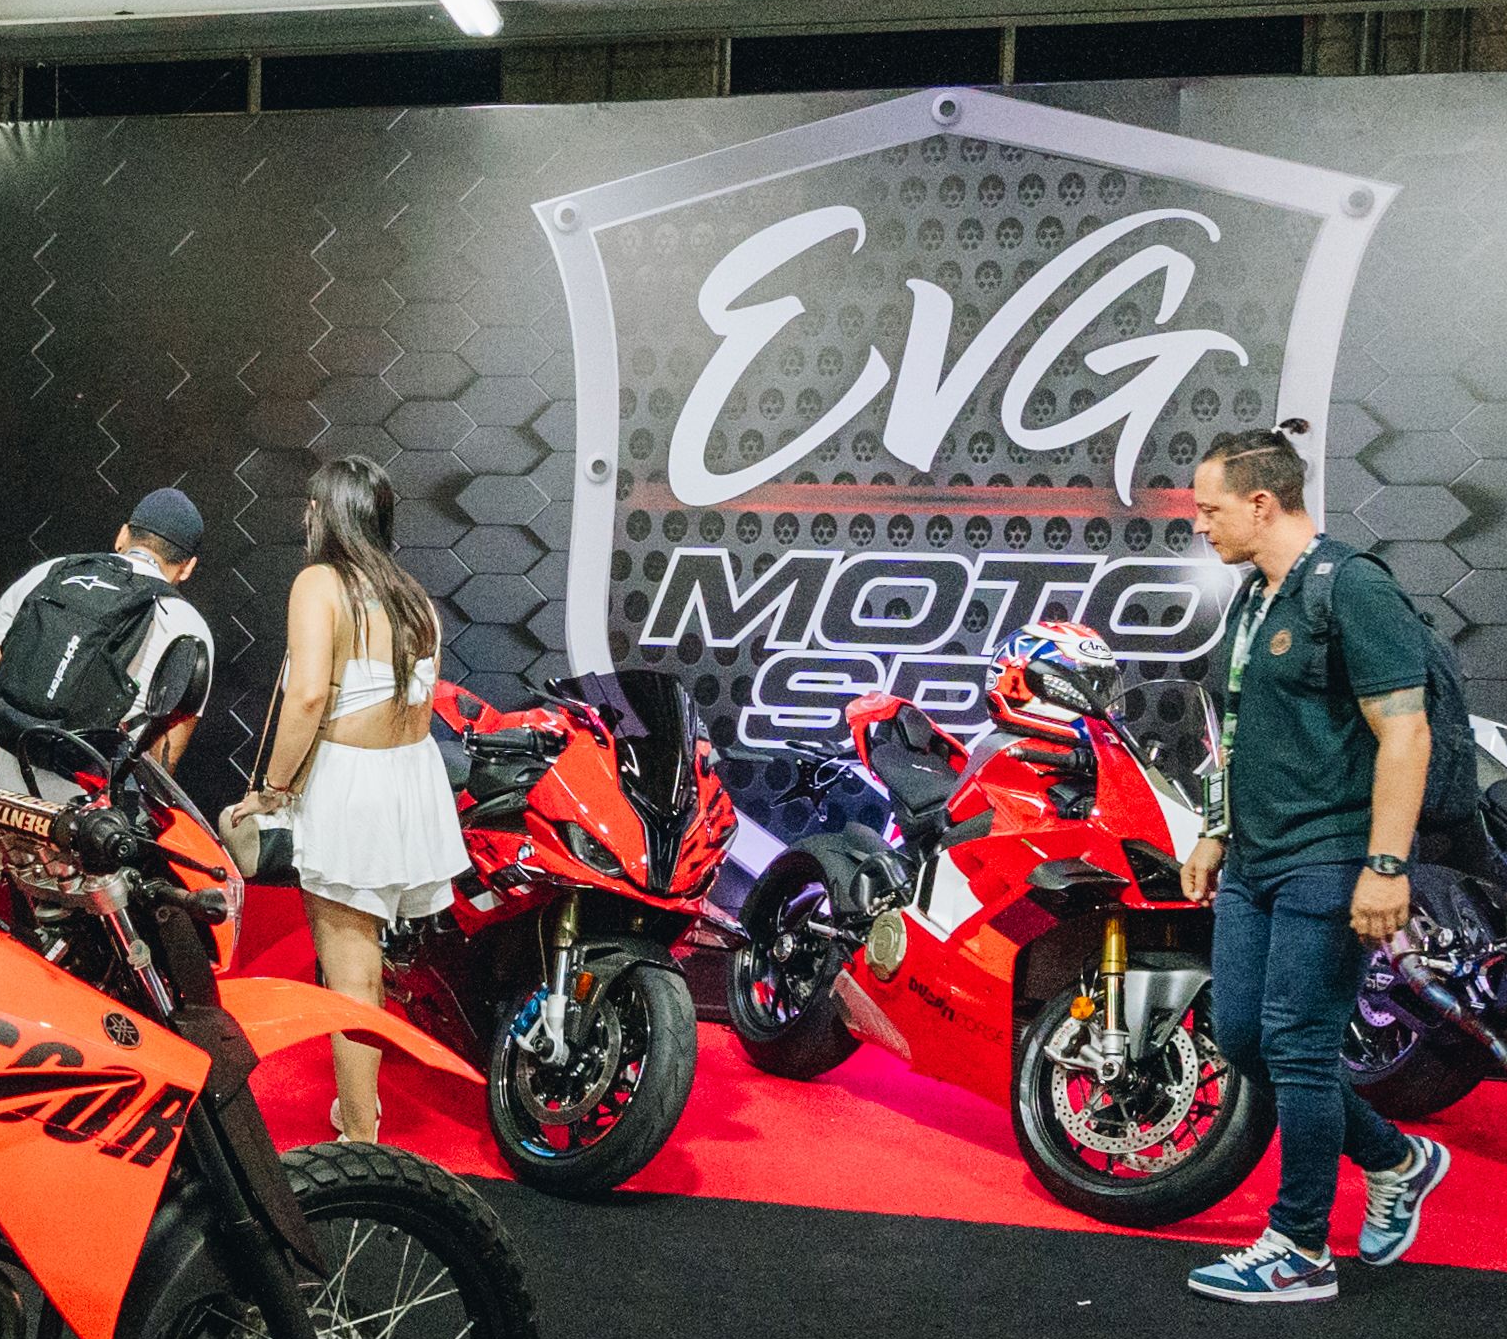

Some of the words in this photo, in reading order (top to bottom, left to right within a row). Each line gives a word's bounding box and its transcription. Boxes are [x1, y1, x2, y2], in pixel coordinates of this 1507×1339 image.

[638, 546, 1247, 662] MOTO
[737, 650, 998, 753] SP
[908, 975, 956, 1023] DUCATI
